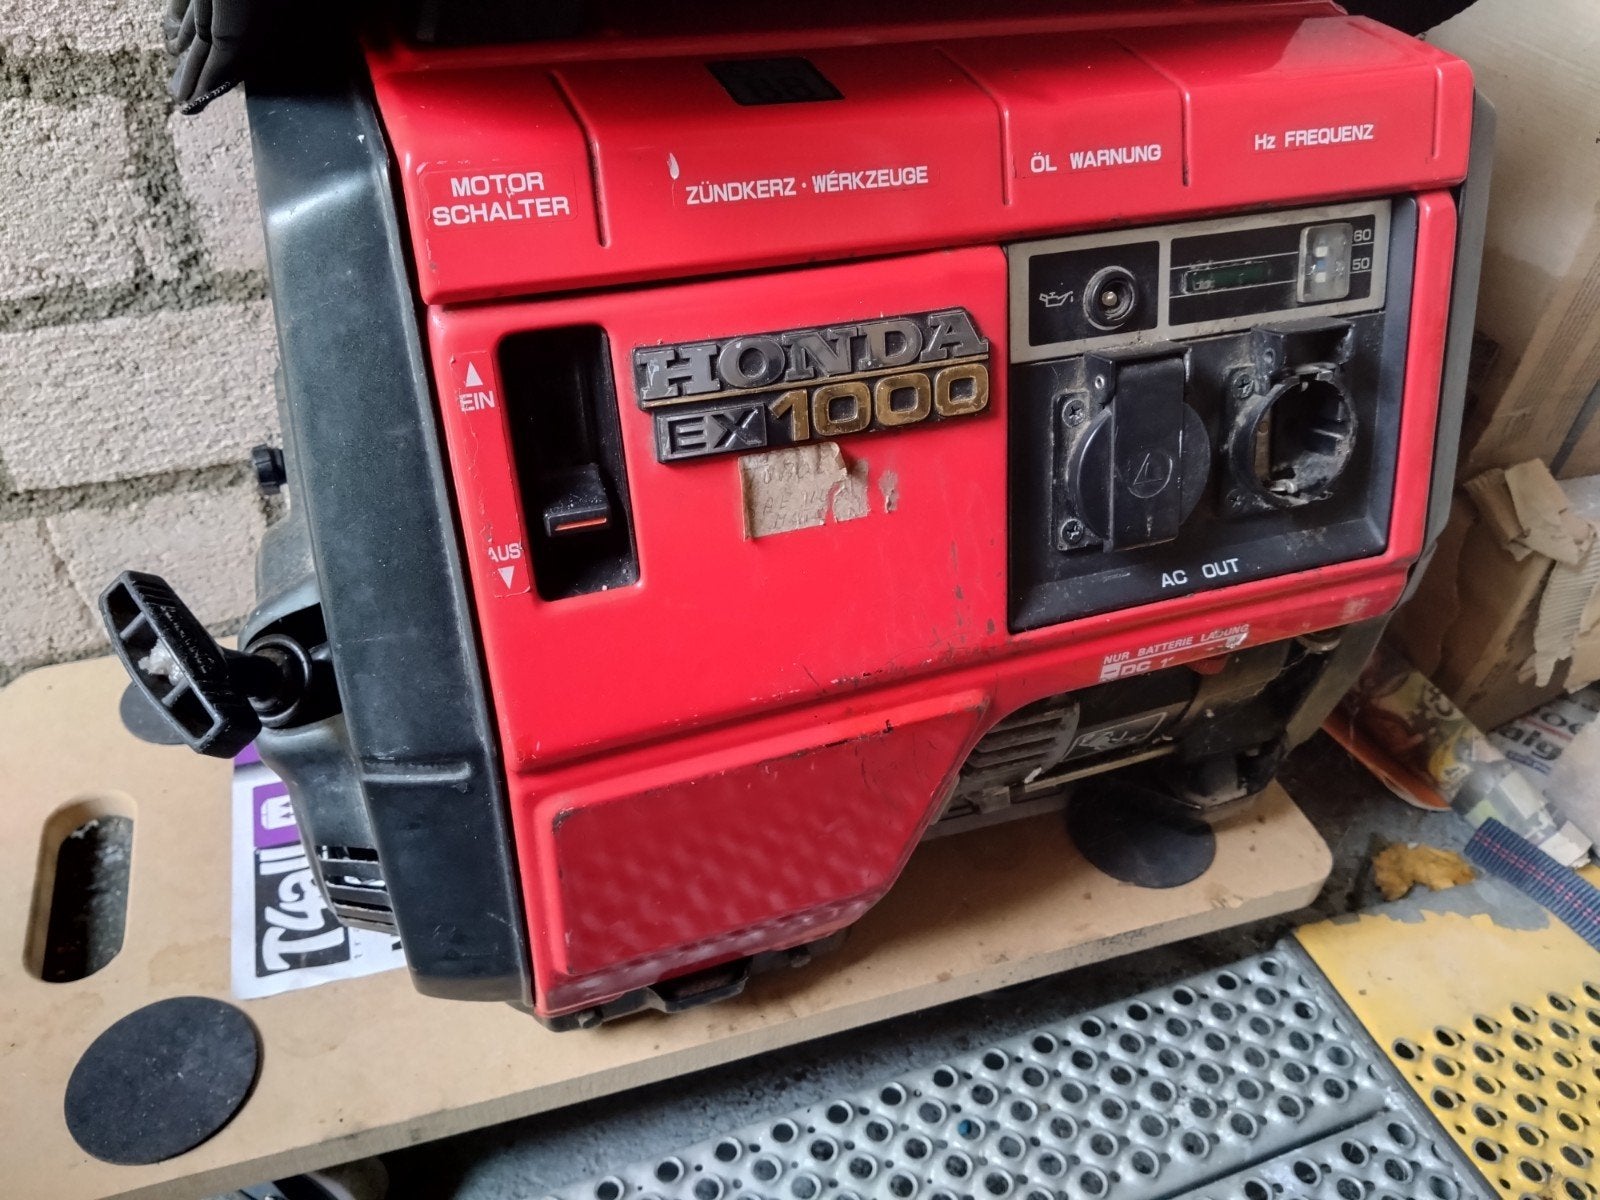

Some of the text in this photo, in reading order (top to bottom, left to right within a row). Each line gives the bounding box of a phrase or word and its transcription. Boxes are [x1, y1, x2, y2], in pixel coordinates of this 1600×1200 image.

[1254, 124, 1375, 152] Hz FREQUENZ
[1030, 144, 1162, 174] ÖL WARNUNG
[450, 171, 545, 198] MOTOR
[685, 177, 797, 206] ZÜNDKERZ
[432, 196, 571, 227] SCHALTER
[1353, 228, 1372, 242] 60
[1352, 256, 1371, 271] 50
[638, 310, 989, 401] HONDA
[458, 390, 496, 413] EIN
[487, 542, 523, 563] AUS
[1161, 557, 1239, 588] AC OUT
[1103, 651, 1130, 665] NUR
[1137, 636, 1194, 658] BATTERIE
[1120, 660, 1153, 677] DC
